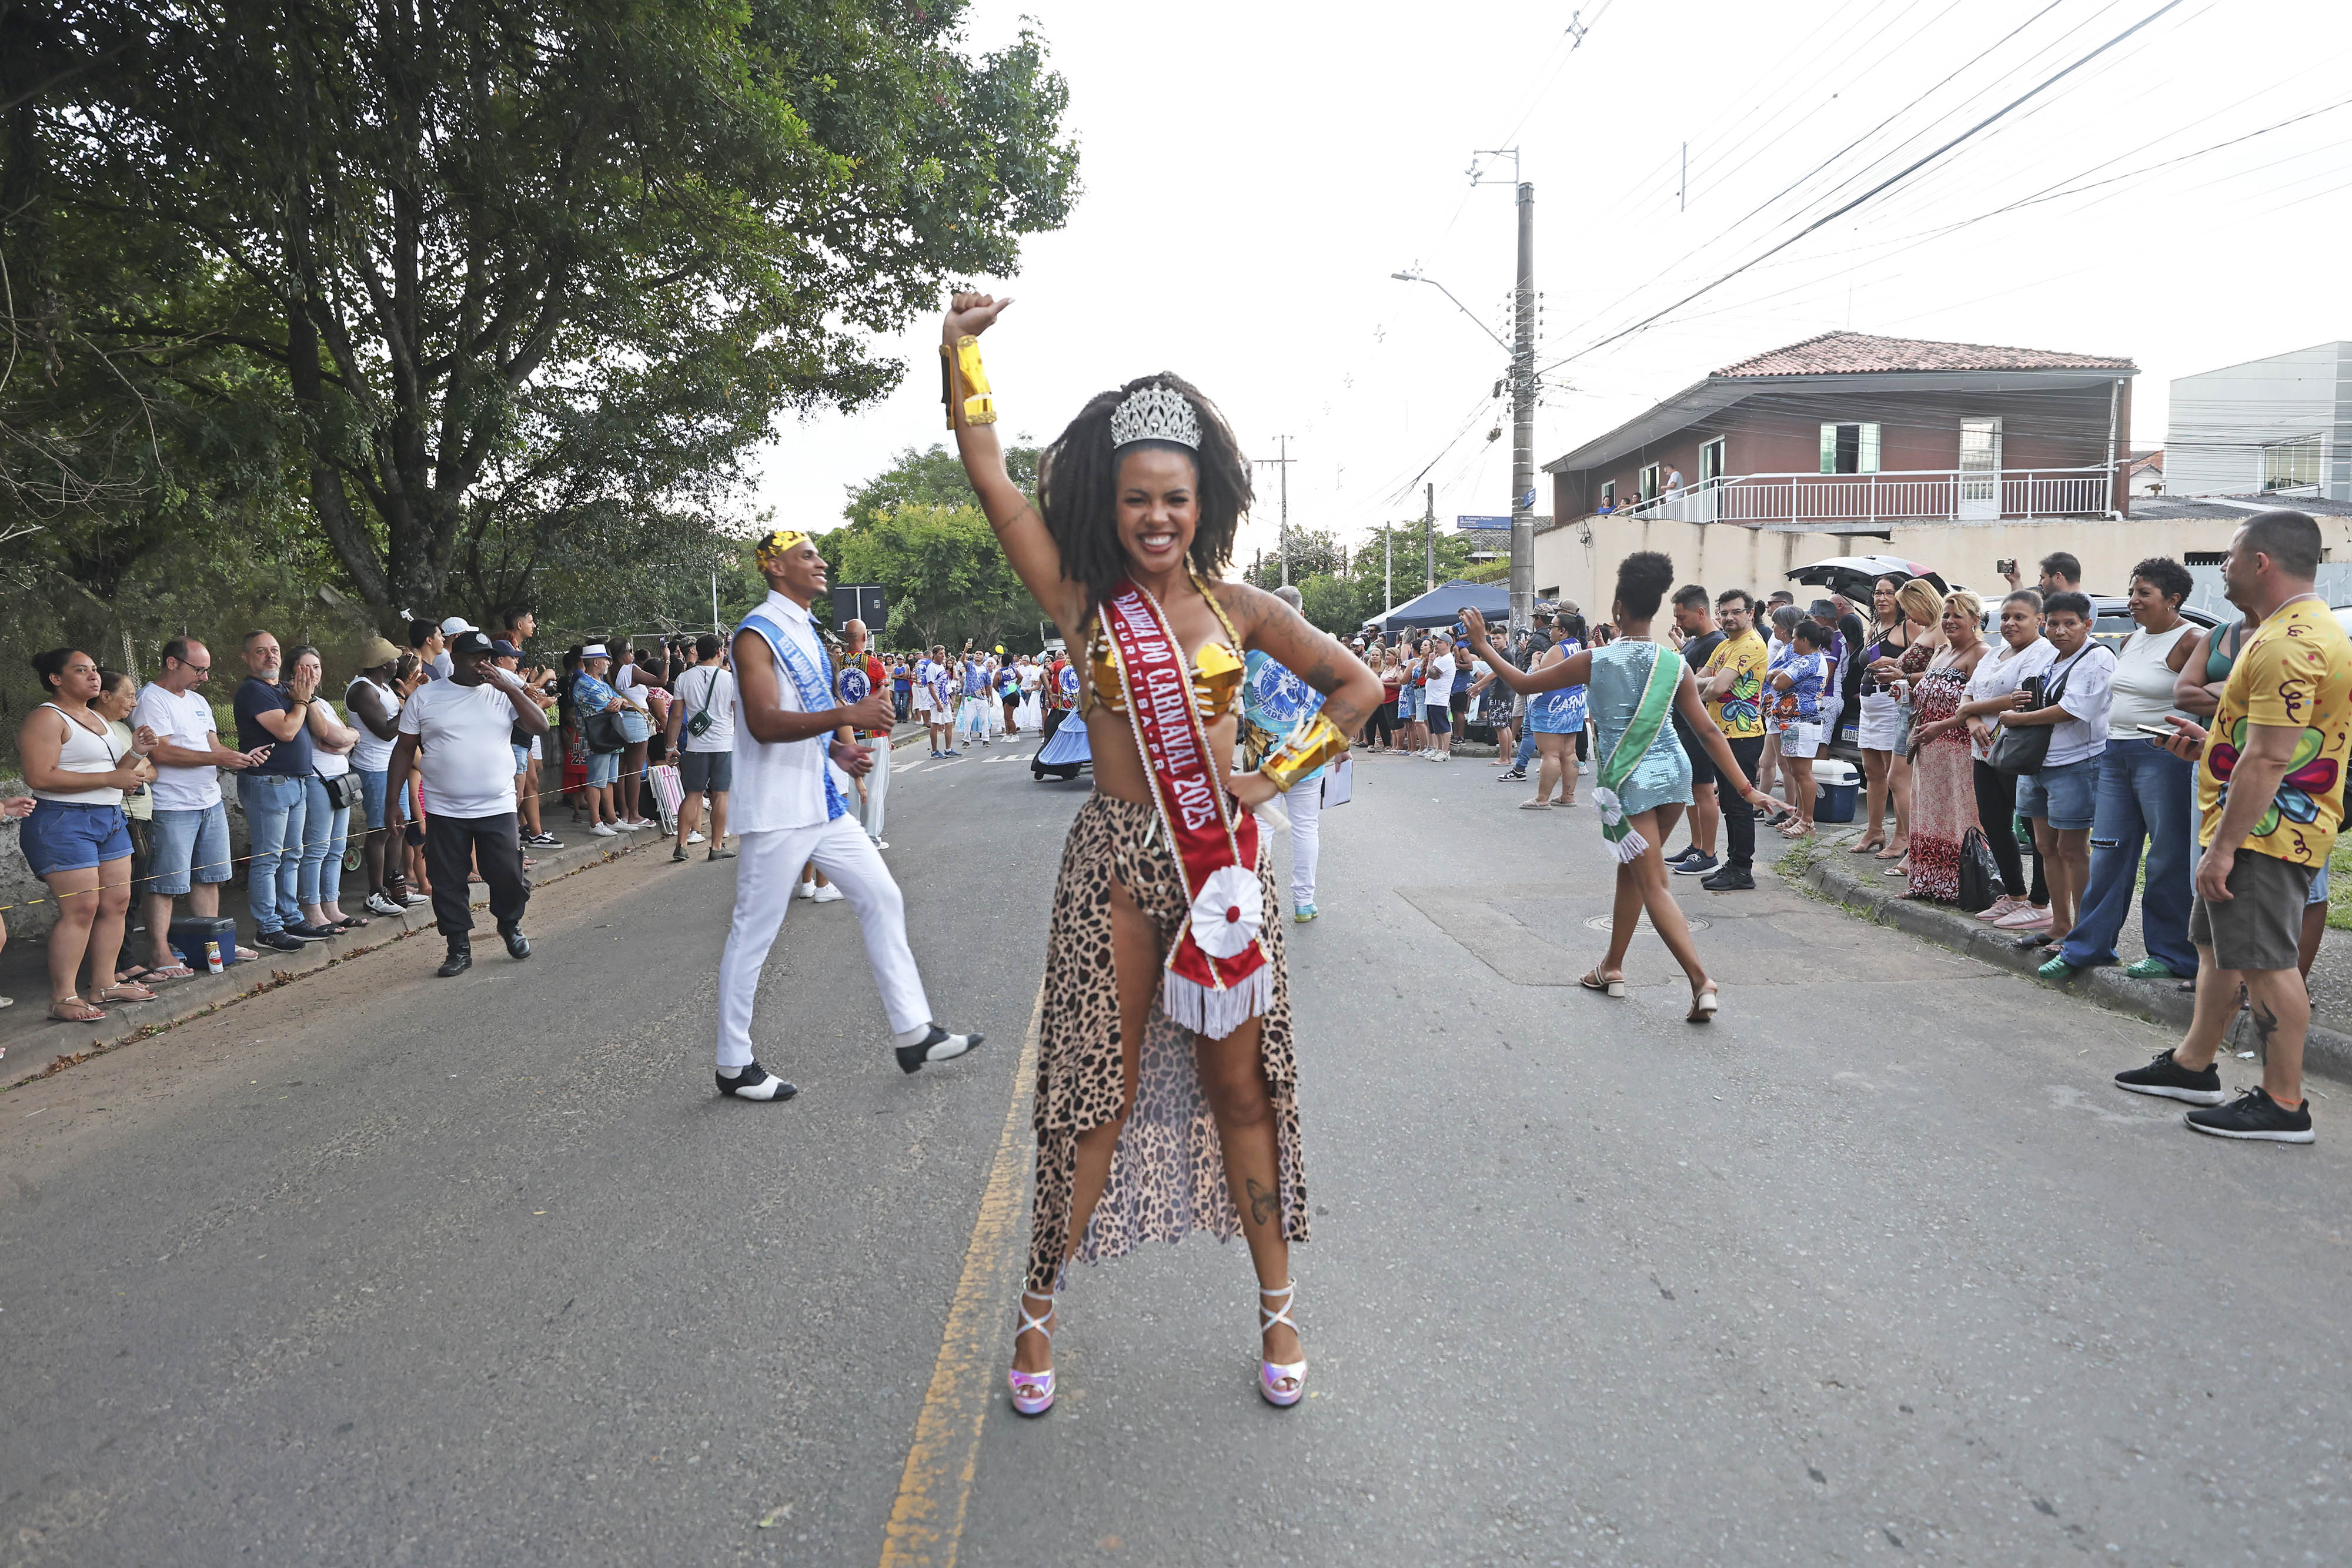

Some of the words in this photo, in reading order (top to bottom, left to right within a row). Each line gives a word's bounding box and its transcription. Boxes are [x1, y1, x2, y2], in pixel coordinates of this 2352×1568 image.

[1112, 590, 1161, 638] RAINHA
[777, 635, 797, 656] REI
[1137, 640, 1172, 663] DO
[1146, 668, 1199, 775] CARNAVAL
[1253, 686, 1284, 721] MOCDADE
[1172, 772, 1217, 831] 2025
